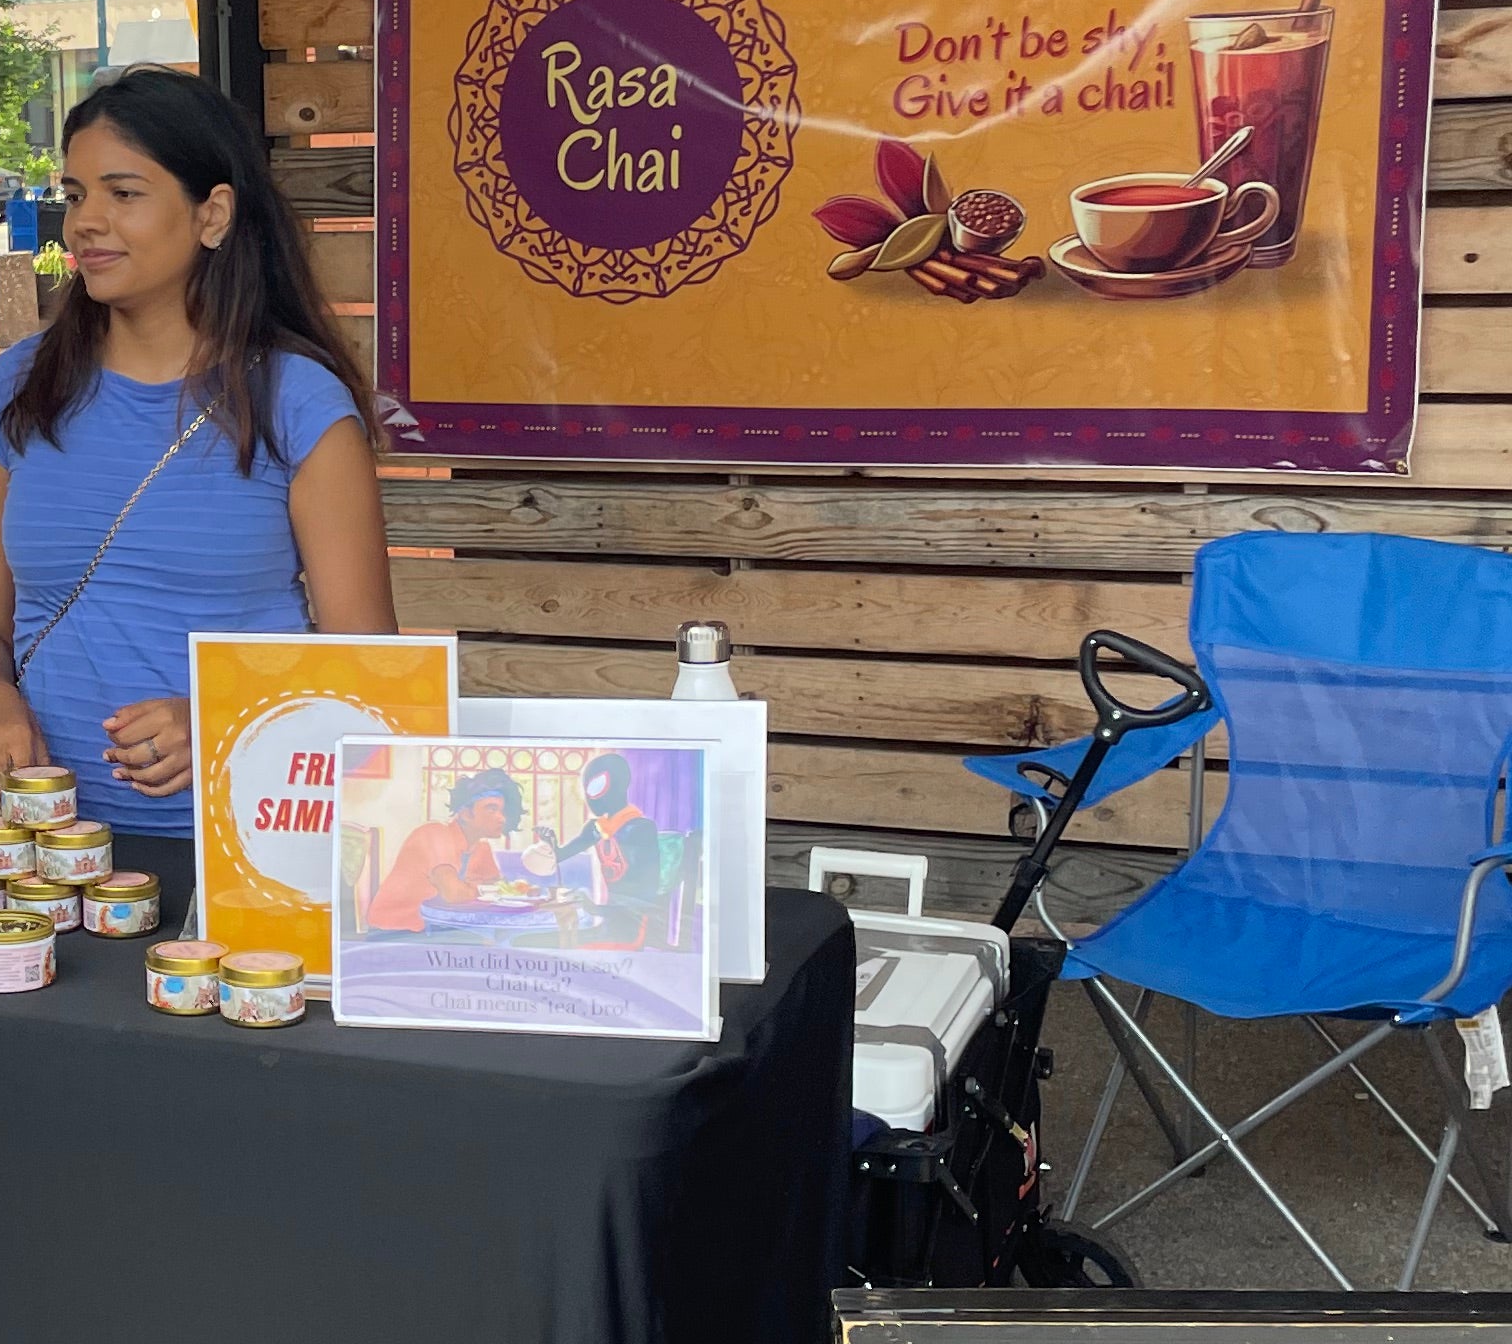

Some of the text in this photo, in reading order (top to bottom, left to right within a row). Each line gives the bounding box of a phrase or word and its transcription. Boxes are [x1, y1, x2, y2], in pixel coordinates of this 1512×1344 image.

[895, 8, 1166, 72] Don't be shy,
[541, 41, 678, 125] Rasa
[893, 61, 1175, 119] Give it a chai!
[557, 124, 683, 193] Chai
[426, 950, 633, 979] What did you just say?
[486, 975, 528, 992] Chai
[430, 992, 472, 1010] Chai
[476, 997, 538, 1013] means
